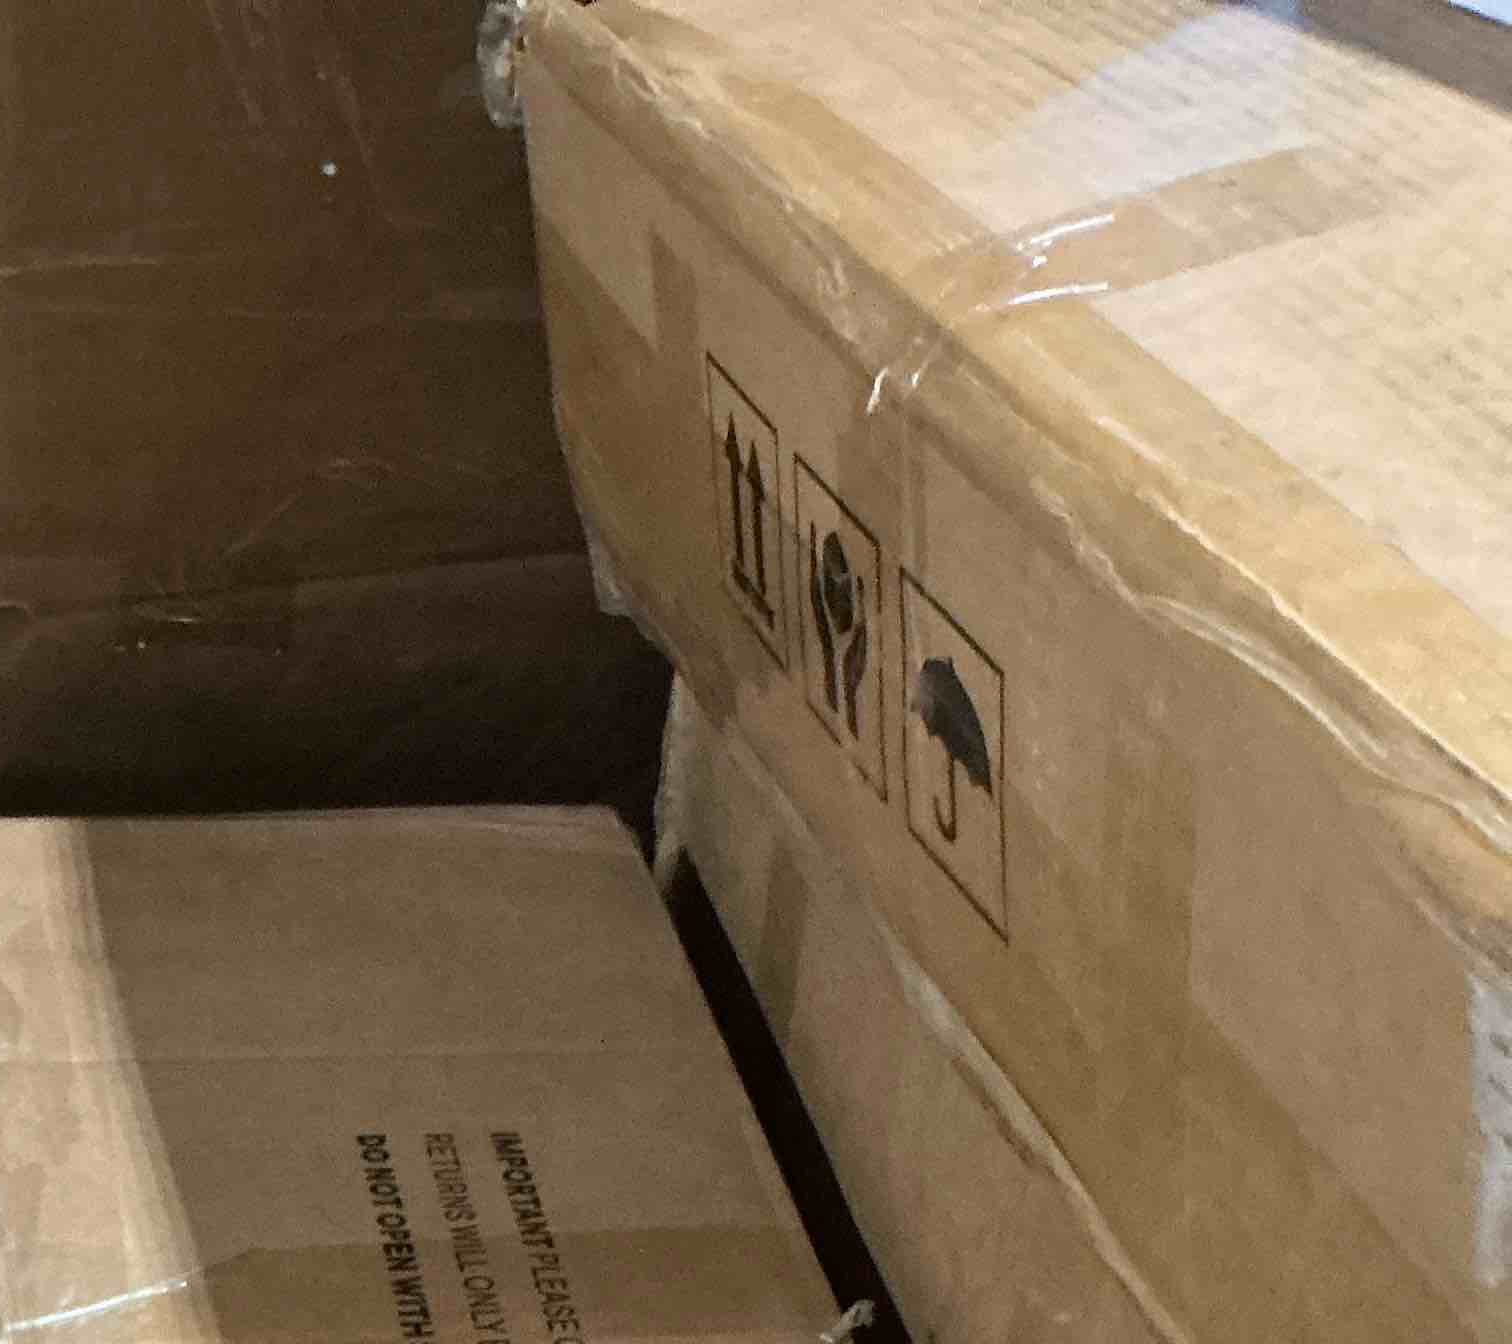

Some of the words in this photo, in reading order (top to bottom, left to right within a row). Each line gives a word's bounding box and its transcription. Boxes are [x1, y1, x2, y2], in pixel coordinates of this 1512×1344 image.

[356, 1133, 390, 1164] DO
[425, 1133, 477, 1223] RETURNS
[364, 1167, 404, 1208] NOT
[377, 1211, 420, 1273] OPEN
[449, 1224, 488, 1273] WILL
[490, 1132, 555, 1250] IMPORTANT
[529, 1251, 580, 1334] PLEASE
[391, 1274, 435, 1339] WITH
[463, 1275, 507, 1335] ONLY
